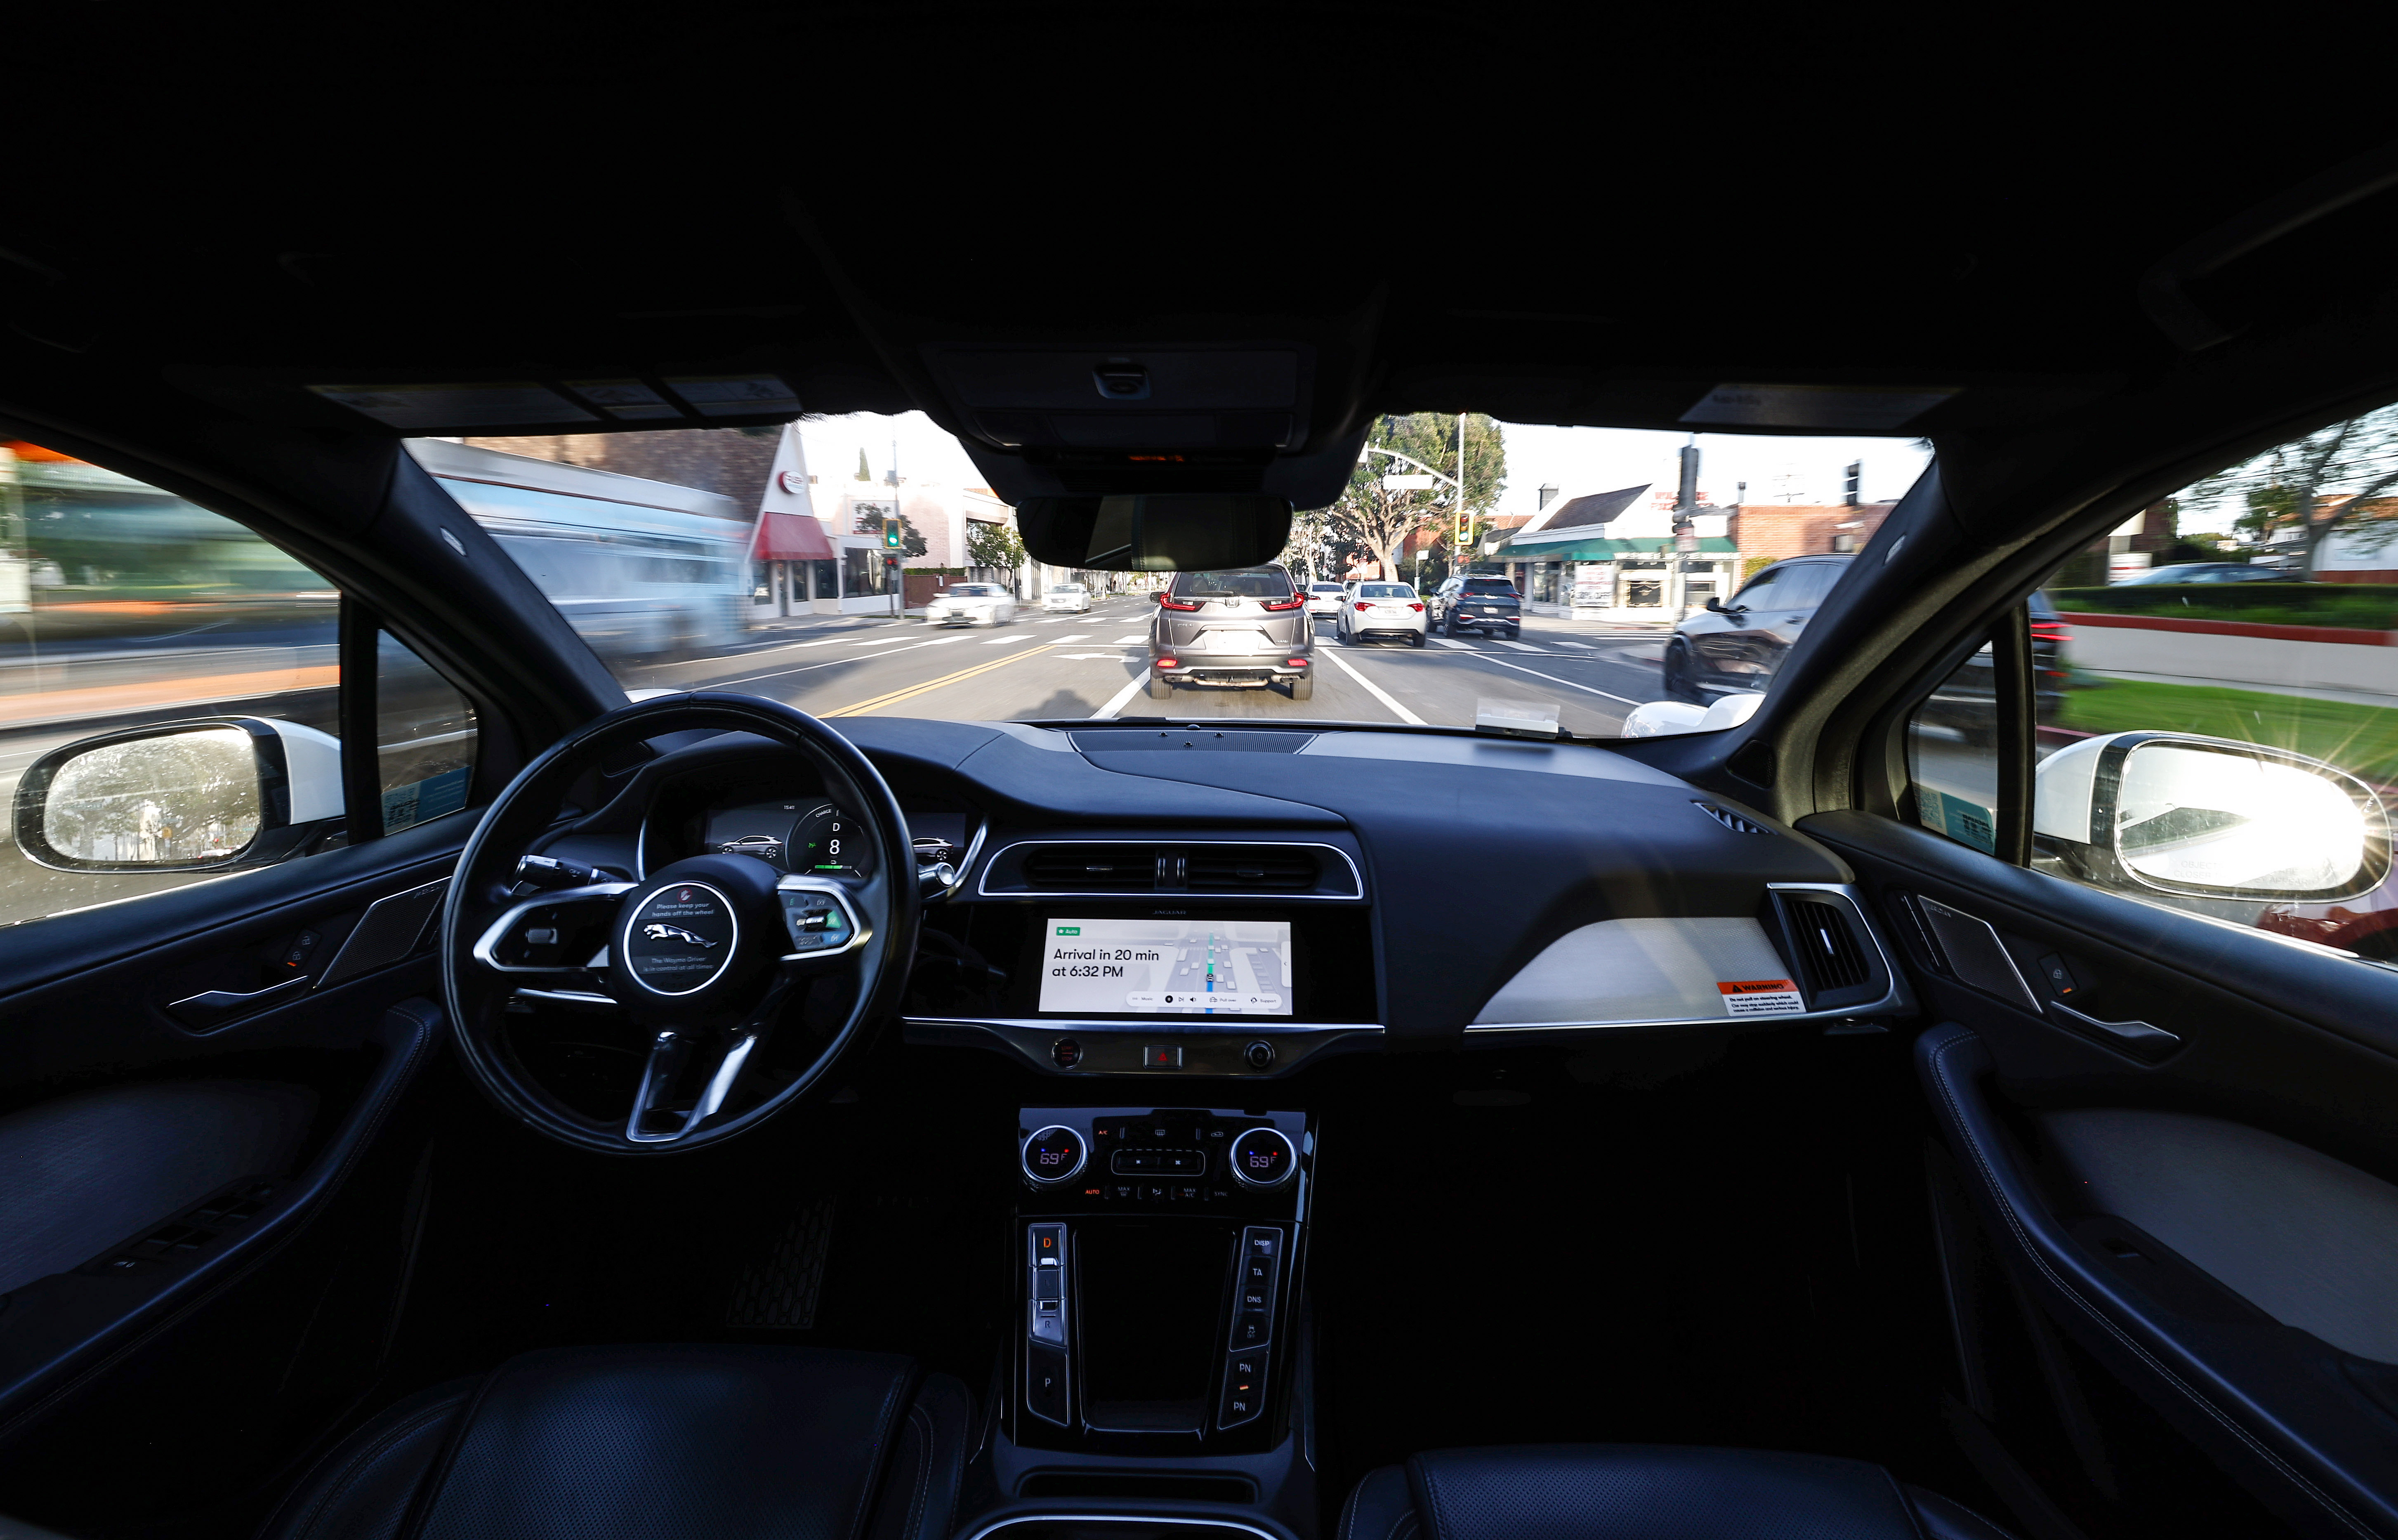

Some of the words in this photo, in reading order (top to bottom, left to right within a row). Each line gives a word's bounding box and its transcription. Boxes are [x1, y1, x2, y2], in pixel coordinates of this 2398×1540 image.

[816, 809, 832, 818] CHARGE
[832, 823, 841, 831] D
[829, 839, 840, 854] 8
[1054, 949, 1095, 960] Arrival
[1099, 949, 1111, 960] in
[1115, 950, 1131, 960] 20
[1135, 950, 1159, 960] min
[1052, 967, 1066, 976] at
[1070, 966, 1099, 977] 6:32
[1103, 966, 1123, 977] PM
[1044, 1238, 1052, 1248] D
[1252, 1268, 1262, 1276] TA
[1239, 1363, 1251, 1373] PN
[1045, 1378, 1051, 1387] P
[1233, 1402, 1245, 1411] PN
